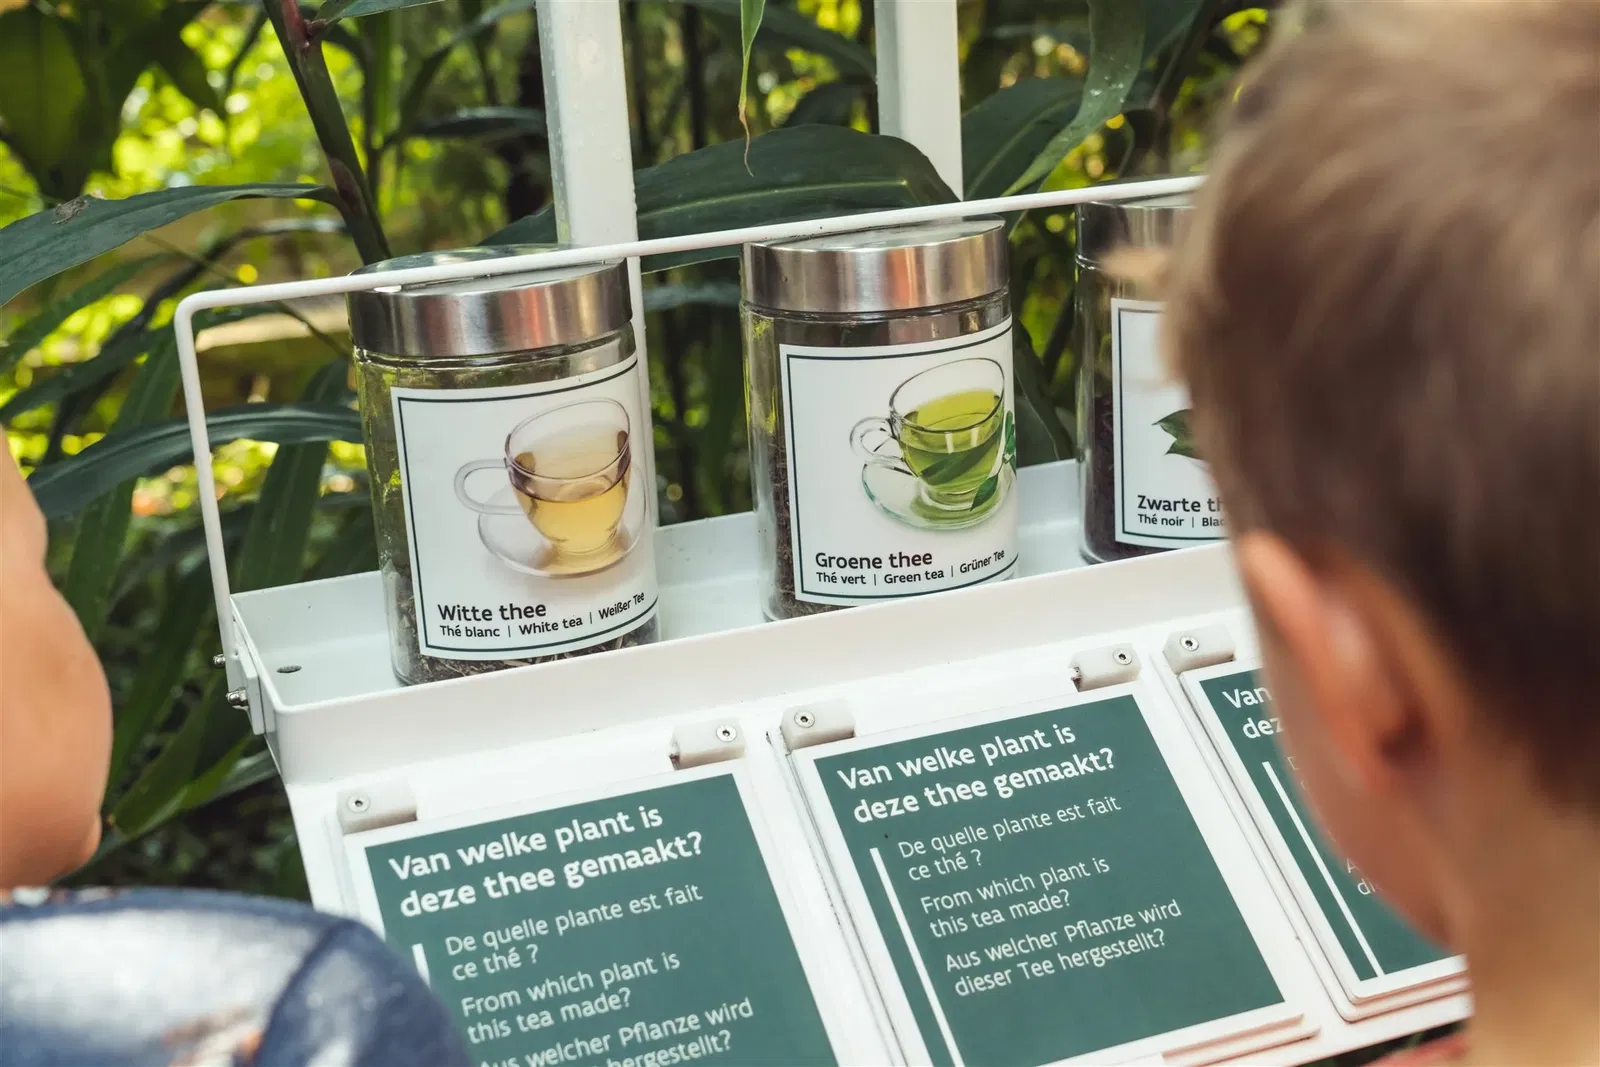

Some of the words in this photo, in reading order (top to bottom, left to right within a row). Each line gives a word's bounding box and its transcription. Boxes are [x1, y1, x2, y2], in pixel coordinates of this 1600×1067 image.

[1137, 494, 1201, 512] Zwarte
[1137, 513, 1158, 525] Thé
[1161, 516, 1184, 526] noir
[1202, 516, 1225, 527] Blac
[815, 552, 882, 569] Groene
[889, 551, 933, 569] thee
[816, 571, 838, 584] Thé
[841, 573, 867, 585] vert
[884, 573, 921, 584] Green
[925, 569, 944, 581] tea
[959, 556, 992, 574] Grüner
[993, 549, 1005, 562] Tee
[438, 603, 493, 622] Witte
[499, 603, 546, 621] thee
[440, 624, 461, 637] Thé
[465, 626, 500, 638] blanc
[518, 620, 559, 636] White
[562, 615, 583, 629] tea
[598, 600, 631, 620] Weißer
[633, 591, 645, 605] Tee
[1221, 687, 1273, 709] Van
[837, 763, 893, 790] Van
[896, 746, 976, 779] welke
[981, 727, 1052, 766] plant
[1052, 723, 1076, 745] is
[1242, 717, 1284, 739] dez
[853, 793, 920, 823] deze
[924, 779, 988, 809] thee
[993, 747, 1116, 799] gemaakt?
[389, 851, 451, 880] Van
[457, 832, 547, 867] welke
[554, 811, 635, 853] plant
[638, 806, 663, 829] is
[898, 839, 927, 858] De
[931, 820, 989, 854] quelle
[993, 810, 1053, 842] plante
[1056, 803, 1085, 823] est
[1087, 794, 1122, 817] fait
[400, 882, 477, 917] deze
[483, 866, 556, 900] thee
[563, 831, 703, 888] gemaakt?
[908, 863, 930, 881] ce
[935, 851, 967, 876] thé
[970, 848, 982, 867] ?
[920, 891, 973, 914] From
[977, 873, 1036, 901] which
[1040, 861, 1092, 890] plant
[1093, 856, 1110, 873] is
[445, 936, 477, 956] De
[483, 912, 549, 948] quelle
[556, 901, 623, 935] plante
[629, 893, 661, 914] est
[665, 884, 703, 908] fait
[929, 916, 968, 939] this
[972, 907, 1005, 927] tea
[1011, 889, 1071, 919] made?
[945, 951, 981, 972] Aus
[984, 932, 1058, 963] welcher
[1064, 911, 1136, 942] Pflanze
[1138, 899, 1182, 926] wird
[452, 962, 478, 981] ce
[484, 948, 522, 975] thé
[526, 944, 538, 964] ?
[461, 991, 521, 1017] From
[526, 970, 594, 1002] which
[599, 957, 658, 990] plant
[662, 951, 680, 971] is
[955, 970, 1012, 996] dieser
[1017, 958, 1055, 980] Tee
[1058, 928, 1166, 967] hergestellt?
[467, 1018, 511, 1044] this
[516, 1008, 554, 1031] tea
[560, 987, 631, 1022] made?
[525, 1033, 611, 1067] welcher
[618, 1013, 701, 1047] Pflanze
[704, 997, 753, 1026] wird
